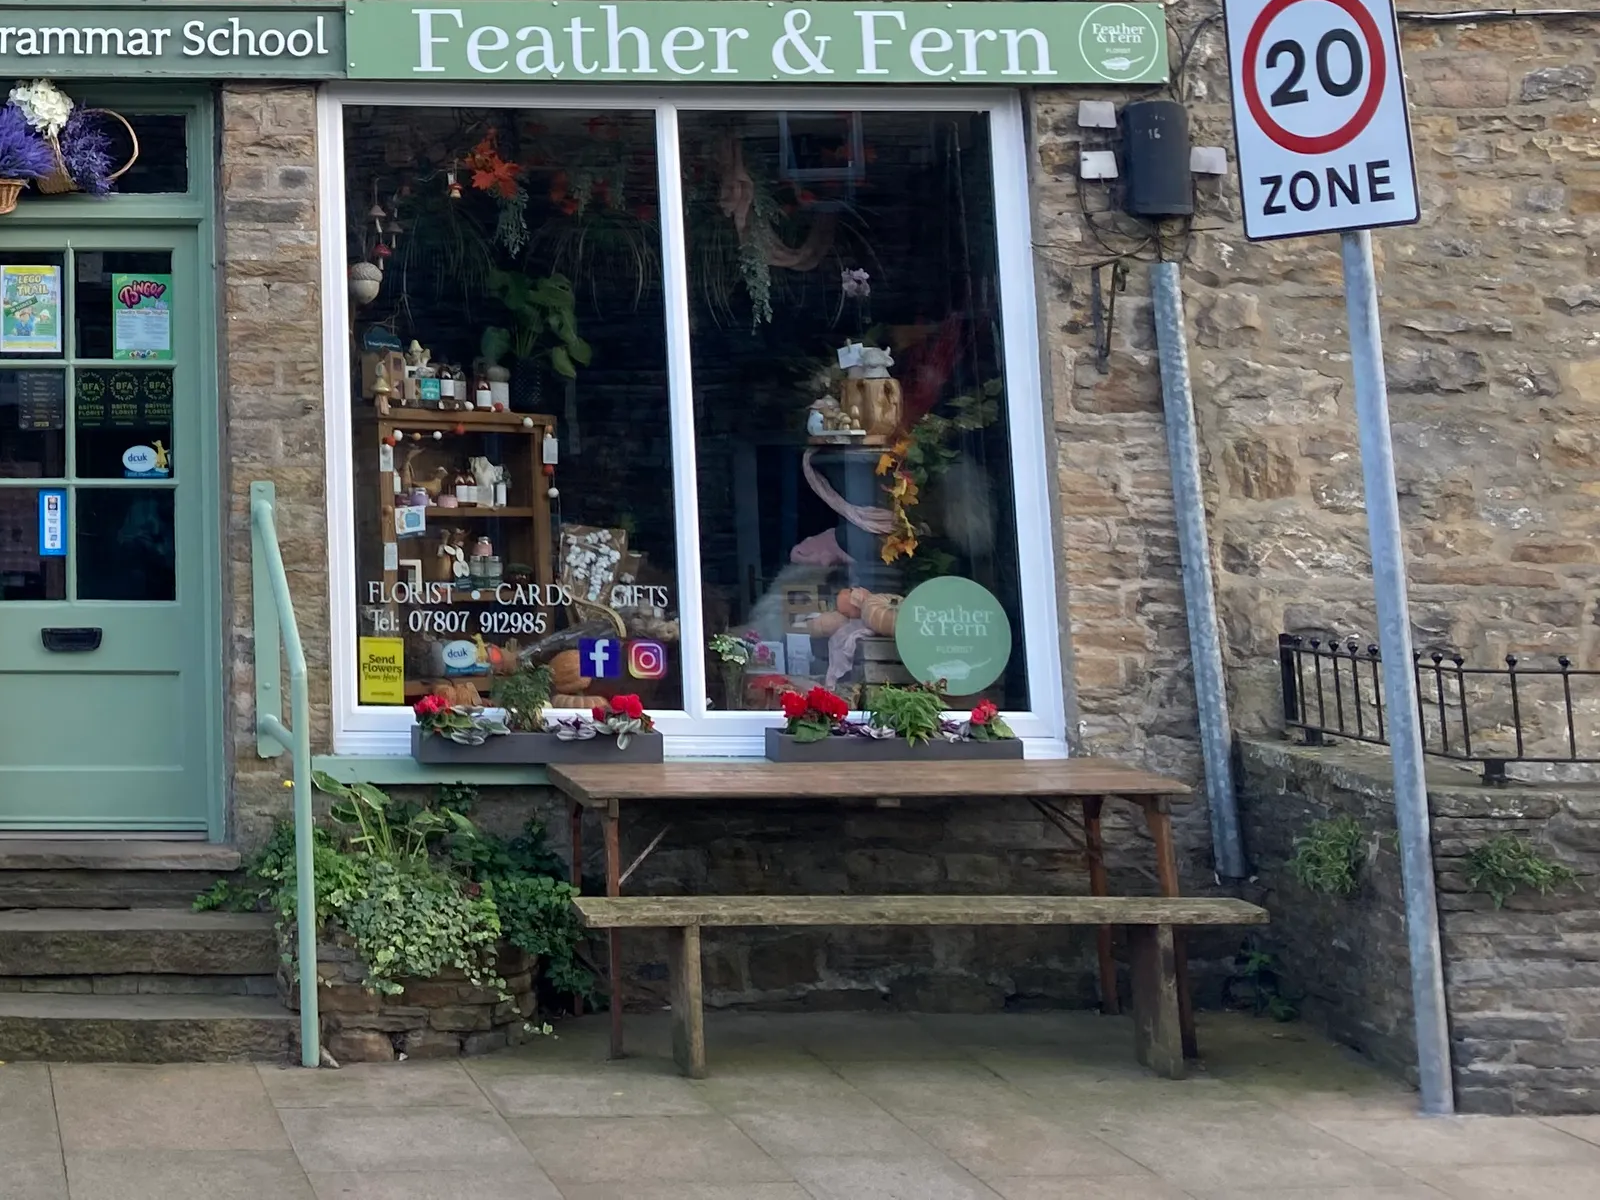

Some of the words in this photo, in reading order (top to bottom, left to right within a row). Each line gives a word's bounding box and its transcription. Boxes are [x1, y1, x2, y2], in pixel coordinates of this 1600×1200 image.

[1092, 23, 1146, 35] Feather
[182, 16, 328, 58] School
[411, 5, 749, 75] Feather
[772, 9, 835, 76] &
[854, 10, 1058, 77] Fern
[1096, 32, 1108, 43] &
[1110, 32, 1142, 43] Fern
[1265, 28, 1364, 108] 20
[1259, 159, 1396, 217] ZONE
[18, 275, 41, 284] LEGO
[17, 284, 49, 296] TRAIL
[82, 383, 99, 391] BFA
[115, 382, 133, 390] BFA
[149, 381, 166, 389] BFA
[128, 453, 148, 462] dcuk
[368, 582, 455, 605] FLORIST
[495, 584, 573, 607] CARDS
[610, 585, 669, 608] GIFTS
[913, 604, 994, 623] Feather
[370, 609, 400, 633] Tel:
[408, 610, 469, 633] 07807
[479, 611, 547, 634] 912985
[920, 620, 935, 636] &
[939, 620, 988, 636] Fern
[368, 654, 395, 664] Send
[448, 648, 468, 658] dcuk
[362, 663, 402, 673] Flowers
